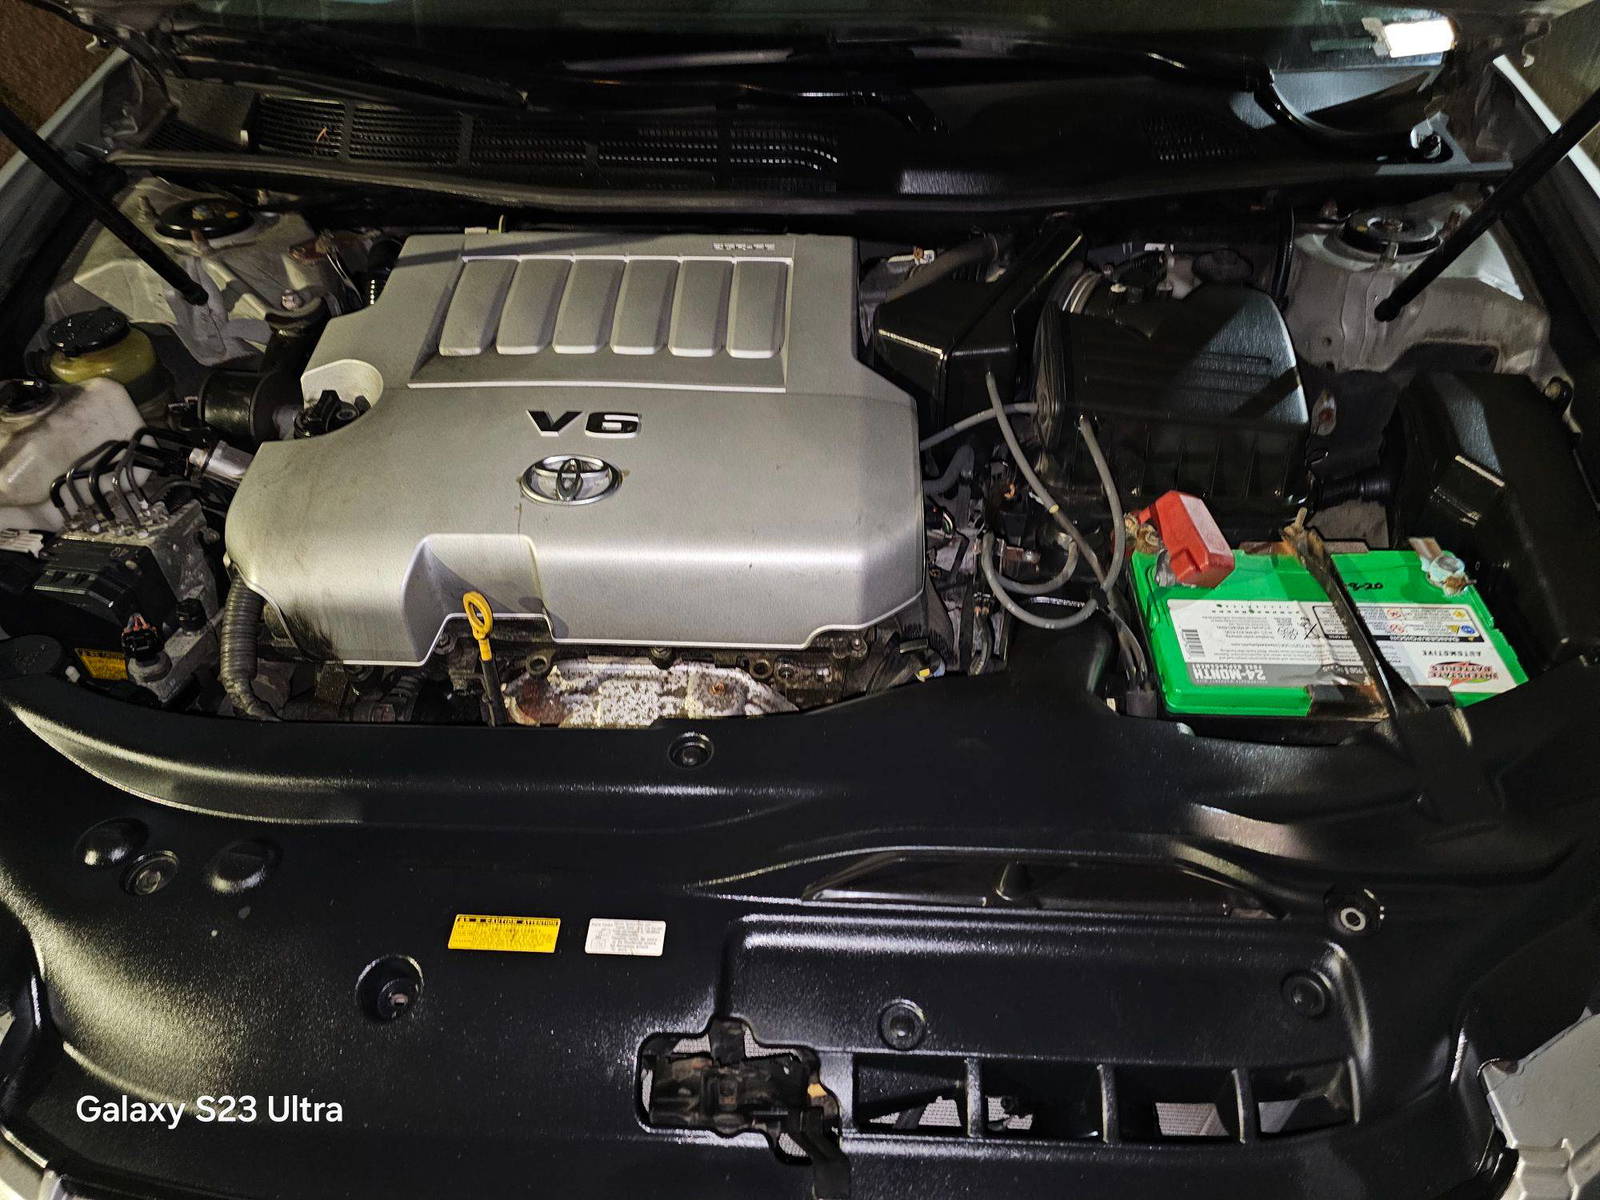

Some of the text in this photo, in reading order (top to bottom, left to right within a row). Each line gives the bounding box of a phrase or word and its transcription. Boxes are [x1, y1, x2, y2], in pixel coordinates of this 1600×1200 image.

[527, 410, 642, 439] V6
[1193, 668, 1266, 681] 24-MONTH
[1431, 665, 1493, 673] BATTERIES
[1429, 672, 1499, 681] INTERSTATE
